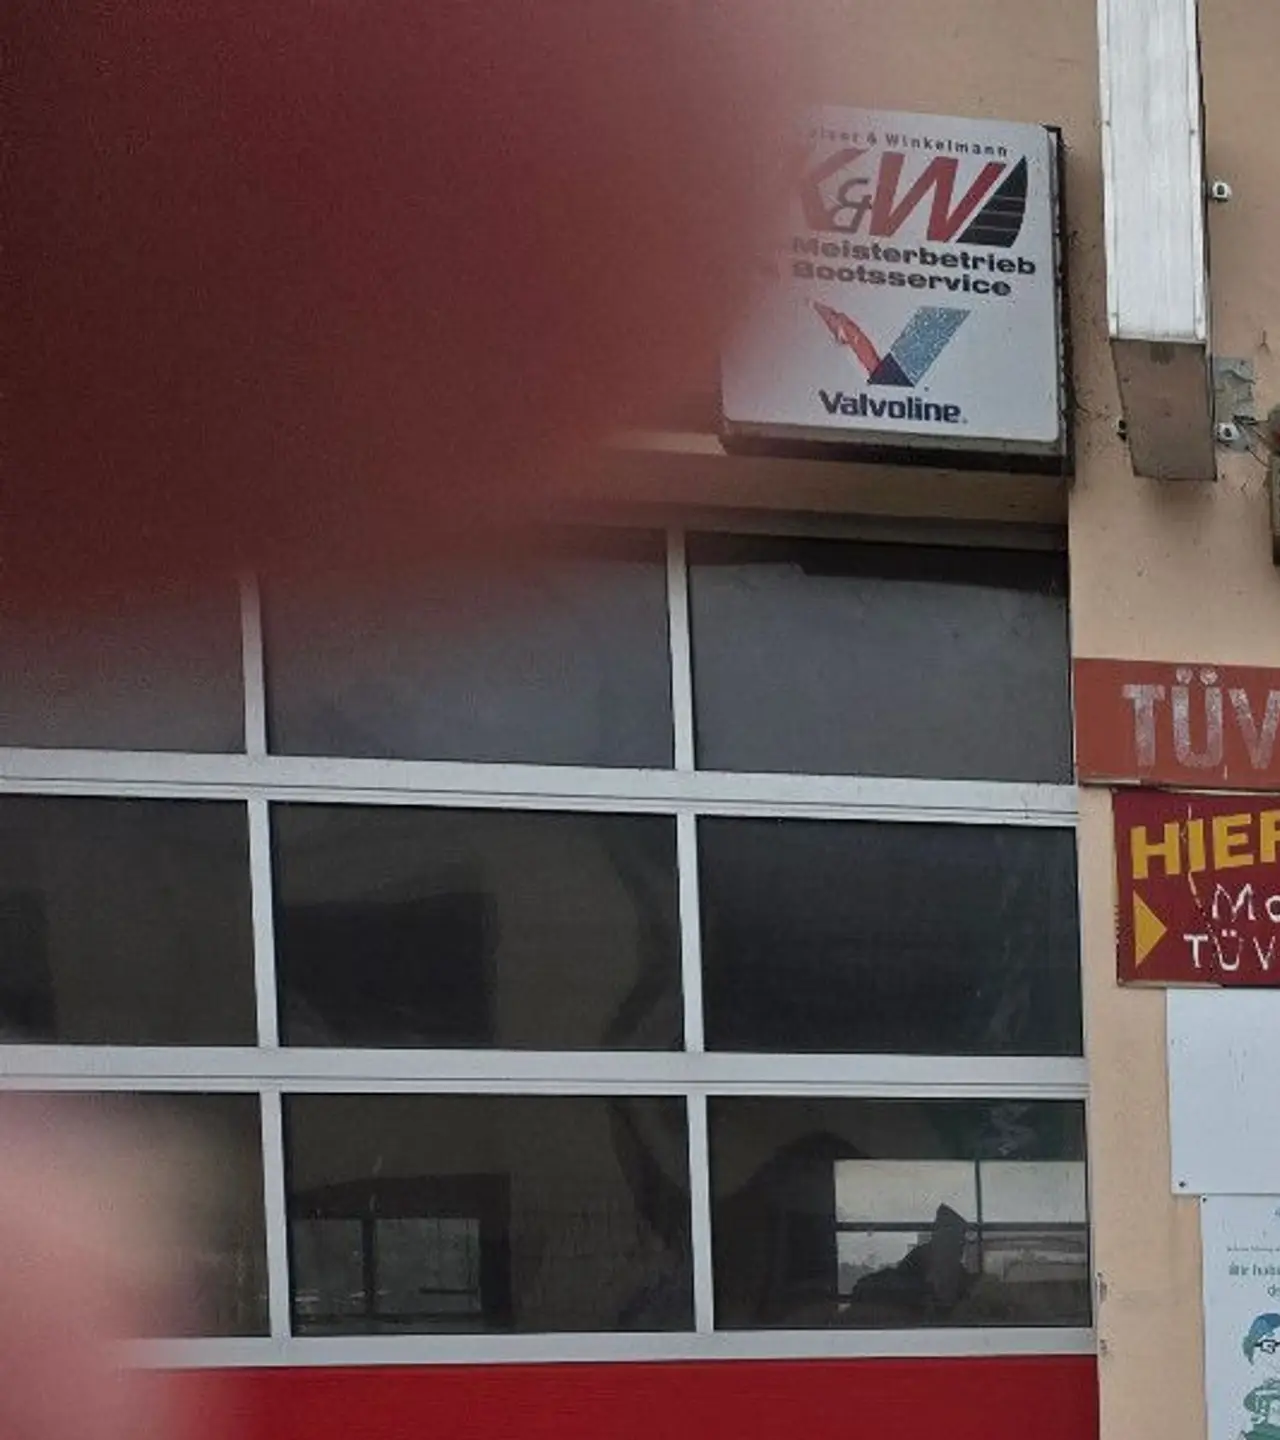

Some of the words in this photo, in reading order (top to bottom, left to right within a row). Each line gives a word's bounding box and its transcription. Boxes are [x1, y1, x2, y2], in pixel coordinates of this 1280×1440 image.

[885, 133, 1009, 157] Winkelmann
[793, 236, 1037, 275] Meisterbetrieb
[792, 260, 1012, 297] Bootsservice
[818, 389, 962, 424] Valvoline
[1183, 928, 1277, 972] TÜV
